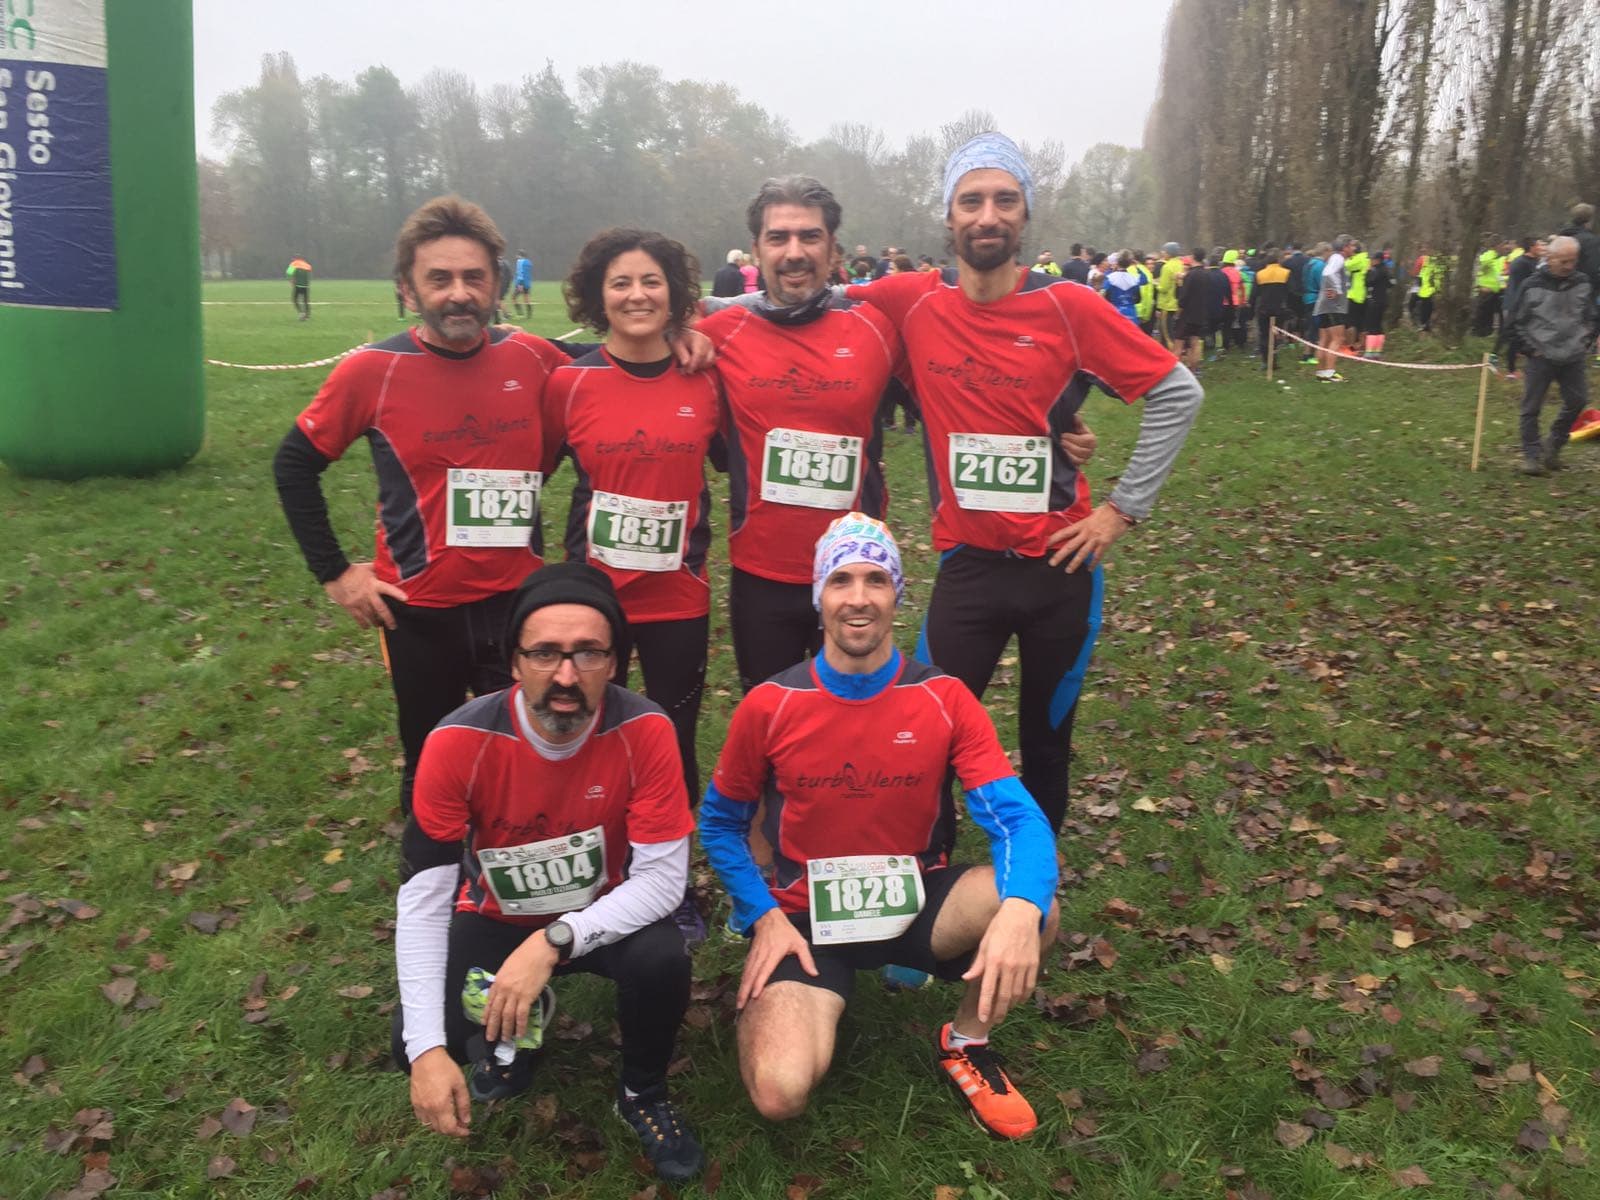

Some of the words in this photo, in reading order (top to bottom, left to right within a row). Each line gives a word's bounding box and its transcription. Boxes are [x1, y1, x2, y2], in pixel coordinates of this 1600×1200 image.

[25, 69, 56, 165] Sesto
[778, 449, 849, 484] 1830
[958, 454, 1038, 486] 2162
[464, 489, 534, 519] 1829
[607, 514, 674, 547] 1831
[504, 852, 596, 893] 1804
[825, 875, 907, 912] 1828
